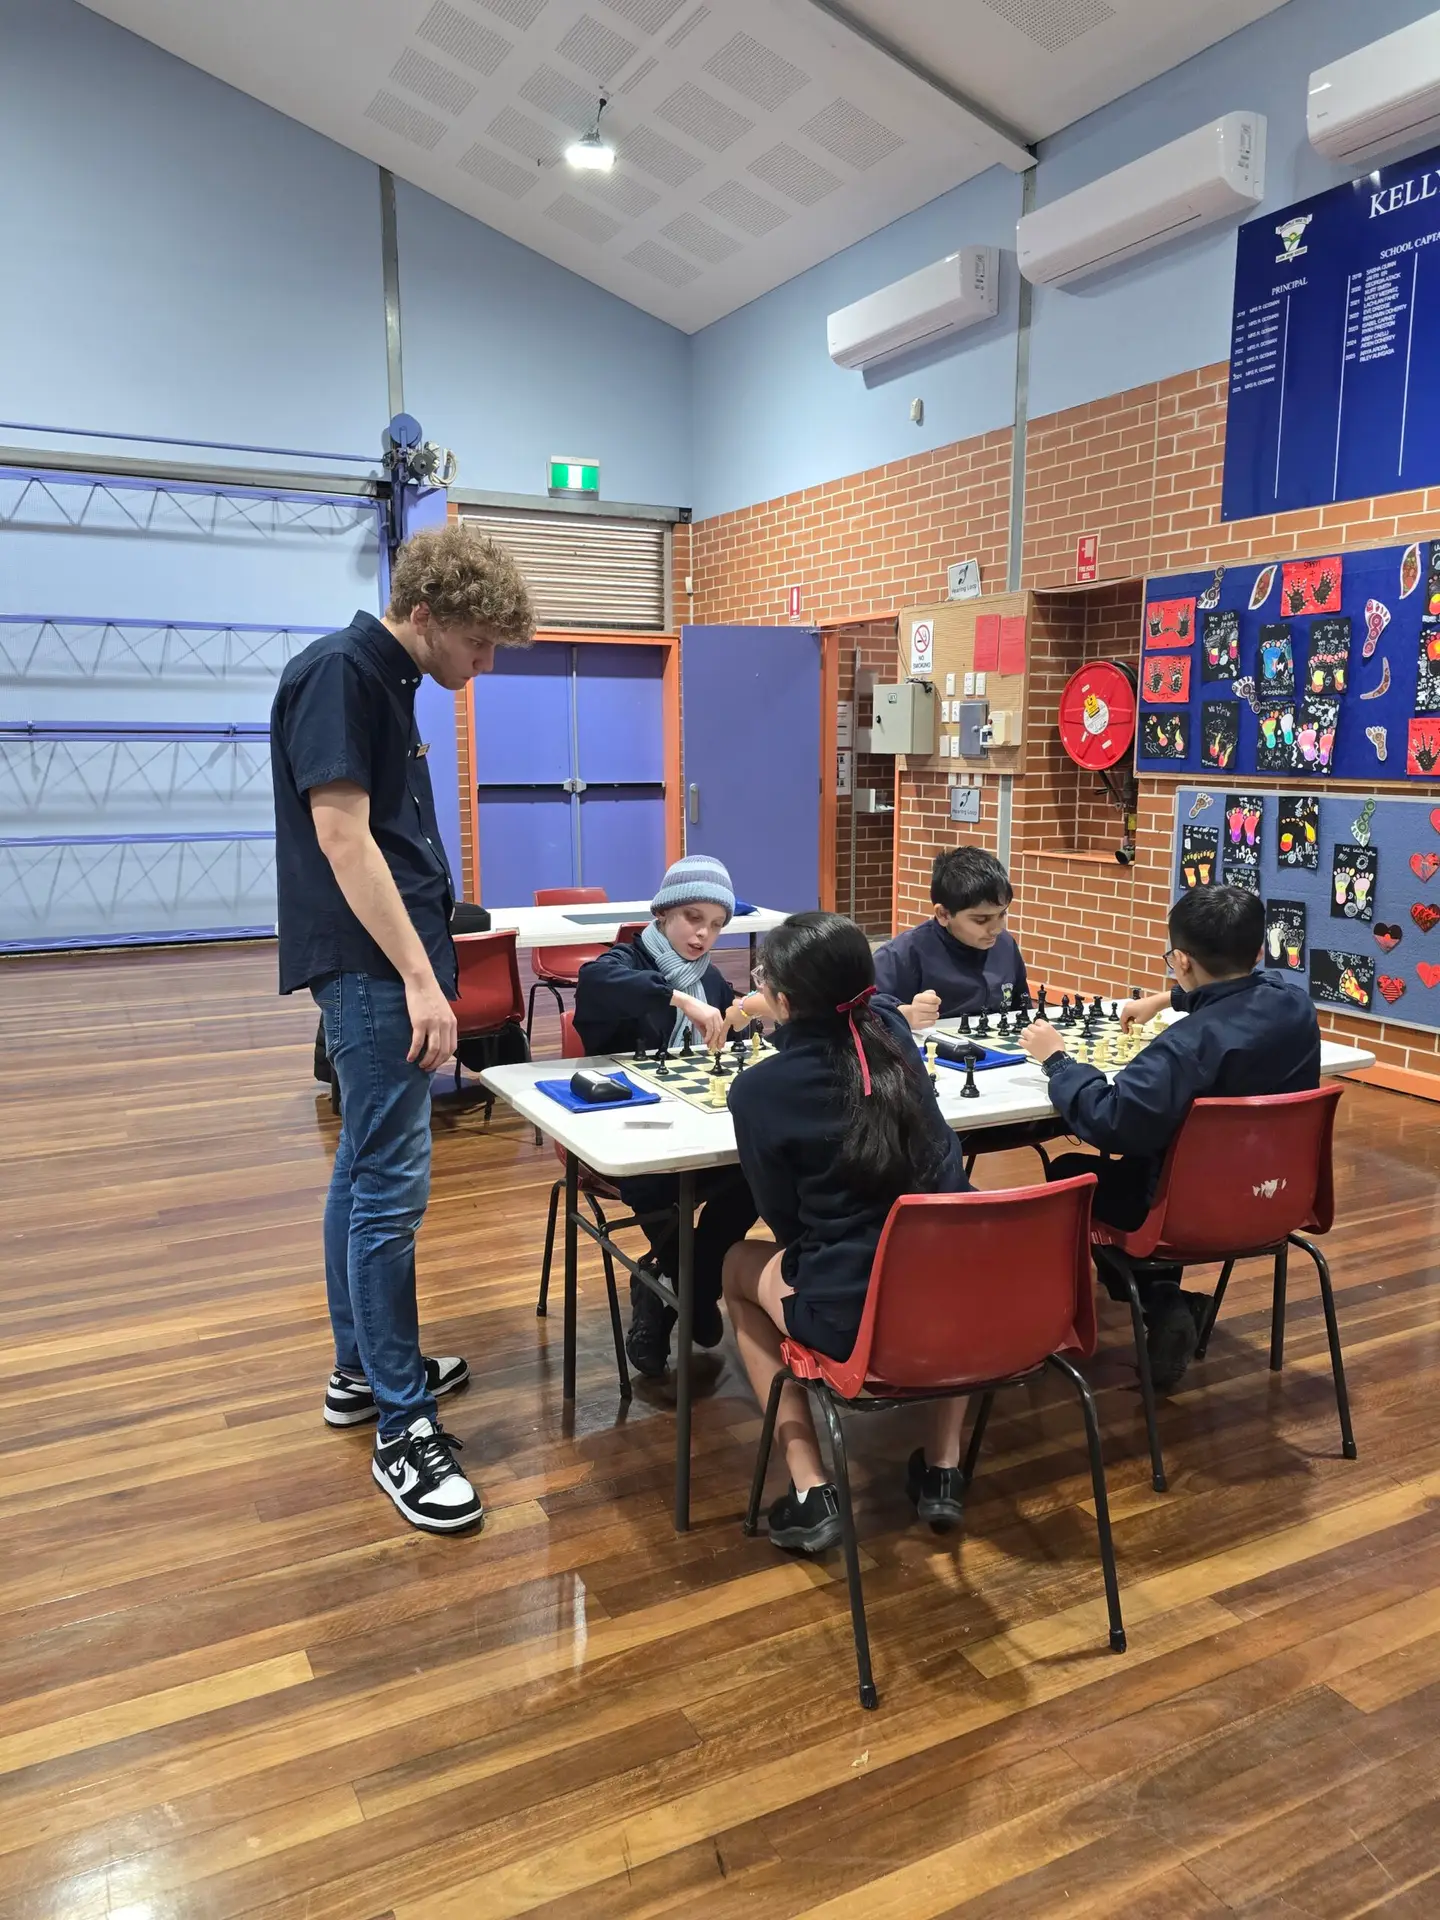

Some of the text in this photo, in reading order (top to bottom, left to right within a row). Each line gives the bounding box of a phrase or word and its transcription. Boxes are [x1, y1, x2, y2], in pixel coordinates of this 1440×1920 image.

[1369, 169, 1440, 219] KELL
[1380, 241, 1414, 260] SCHOOL
[1271, 277, 1309, 296] PRINCIPAL
